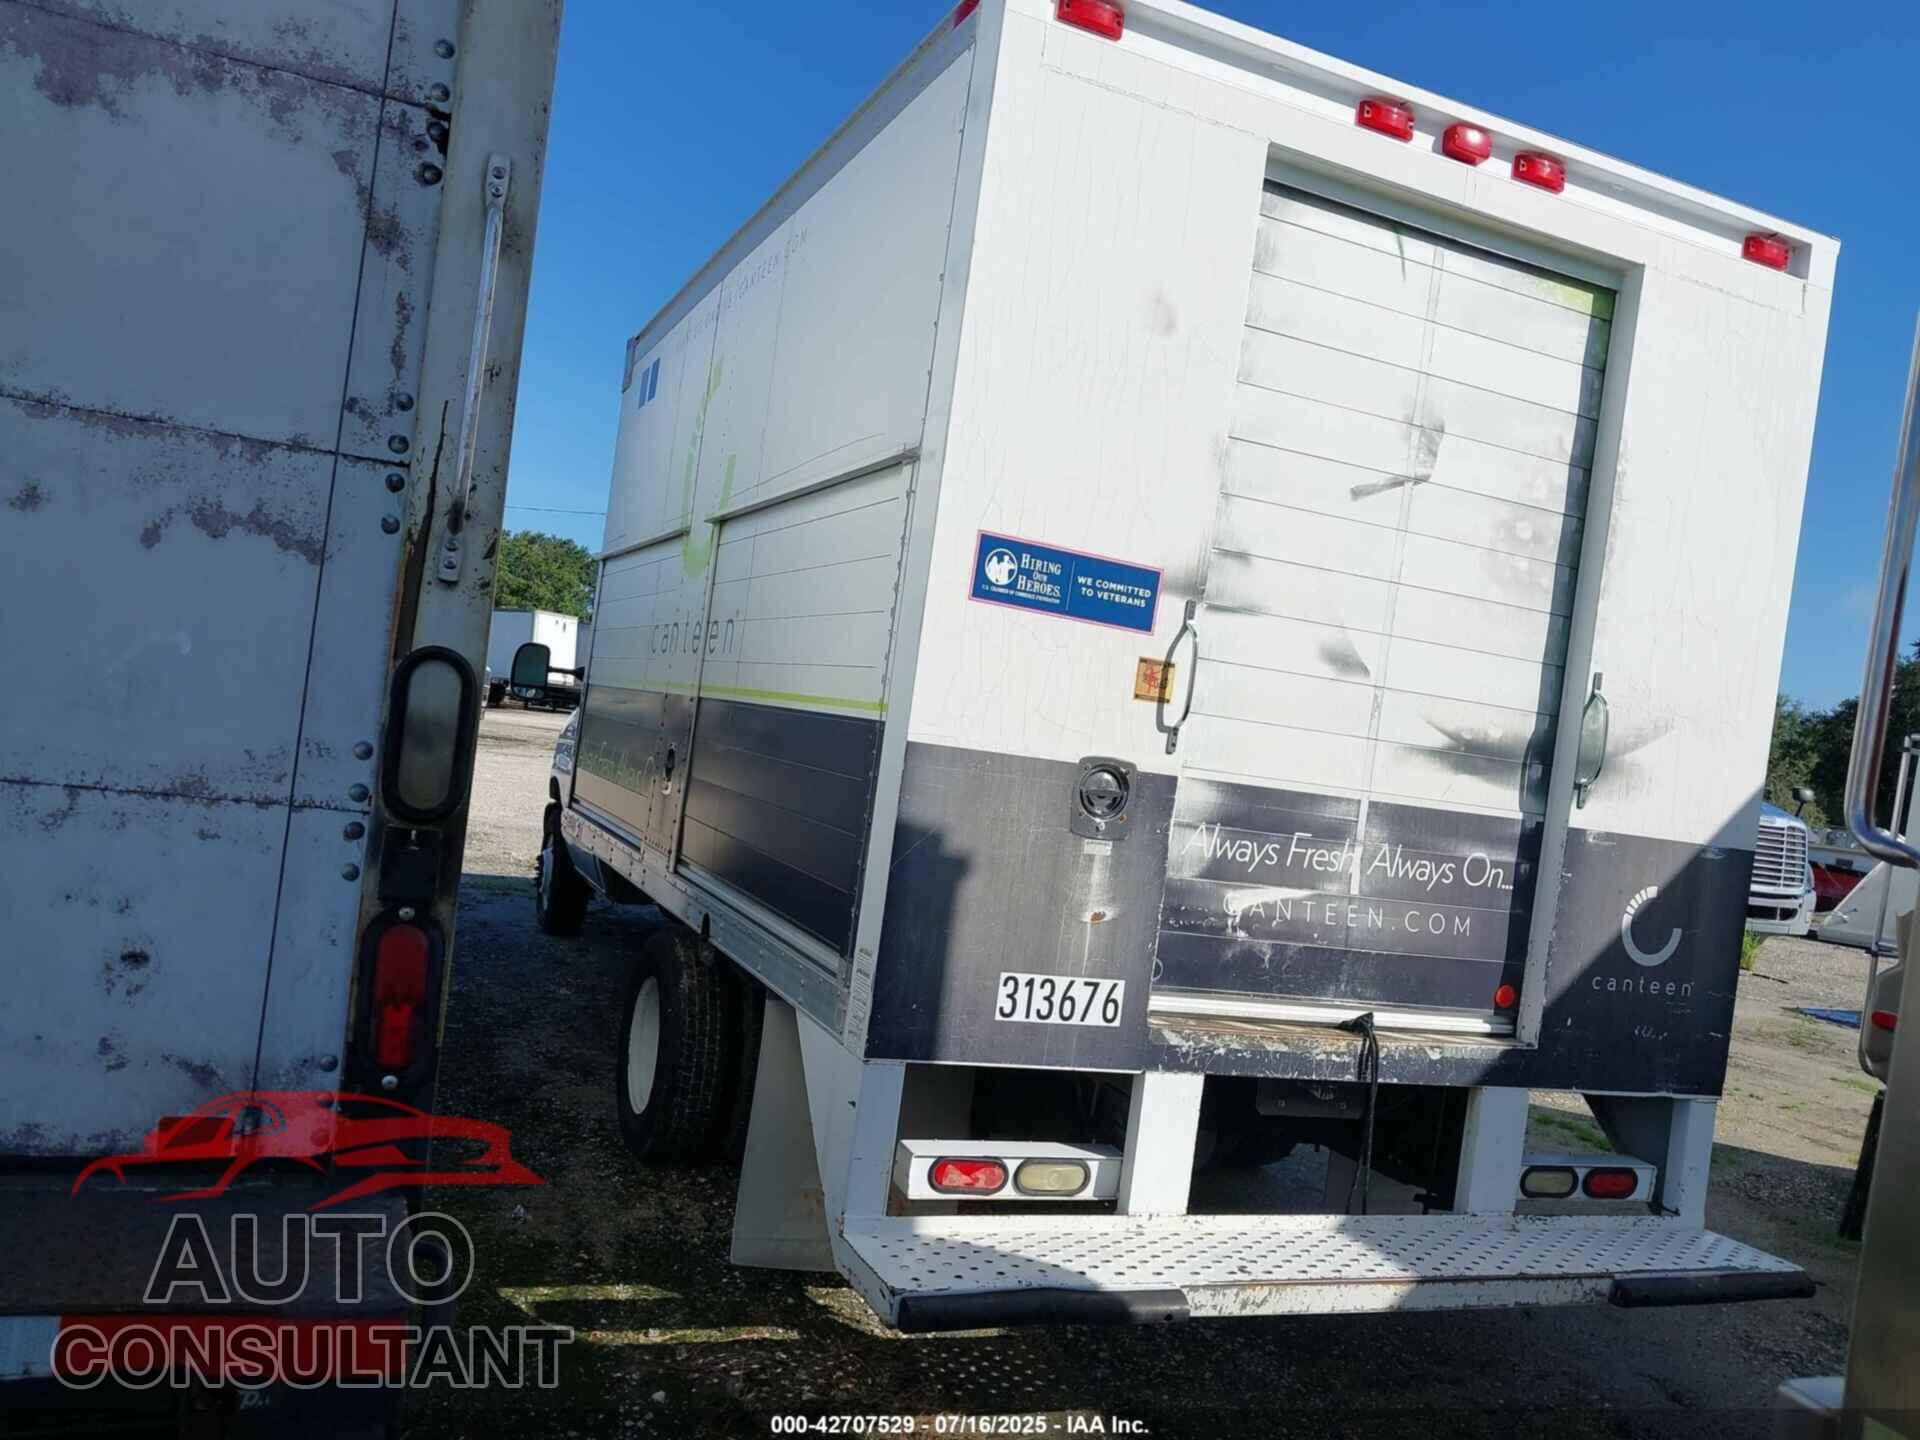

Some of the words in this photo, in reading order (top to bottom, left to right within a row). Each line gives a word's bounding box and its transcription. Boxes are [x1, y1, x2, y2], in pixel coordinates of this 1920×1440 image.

[1020, 553, 1062, 575] HIRING
[1077, 575, 1093, 586] WE
[1095, 579, 1152, 598] COMMITTED
[1081, 587, 1094, 597] TO
[1096, 590, 1147, 608] VETERANS
[1182, 822, 1280, 873] Always
[1286, 832, 1356, 874] Fresh
[1367, 843, 1456, 891] Always
[1223, 893, 1472, 937] CANTEEN.COM
[1592, 976, 1692, 997] canteen
[998, 975, 1120, 1024] 313676
